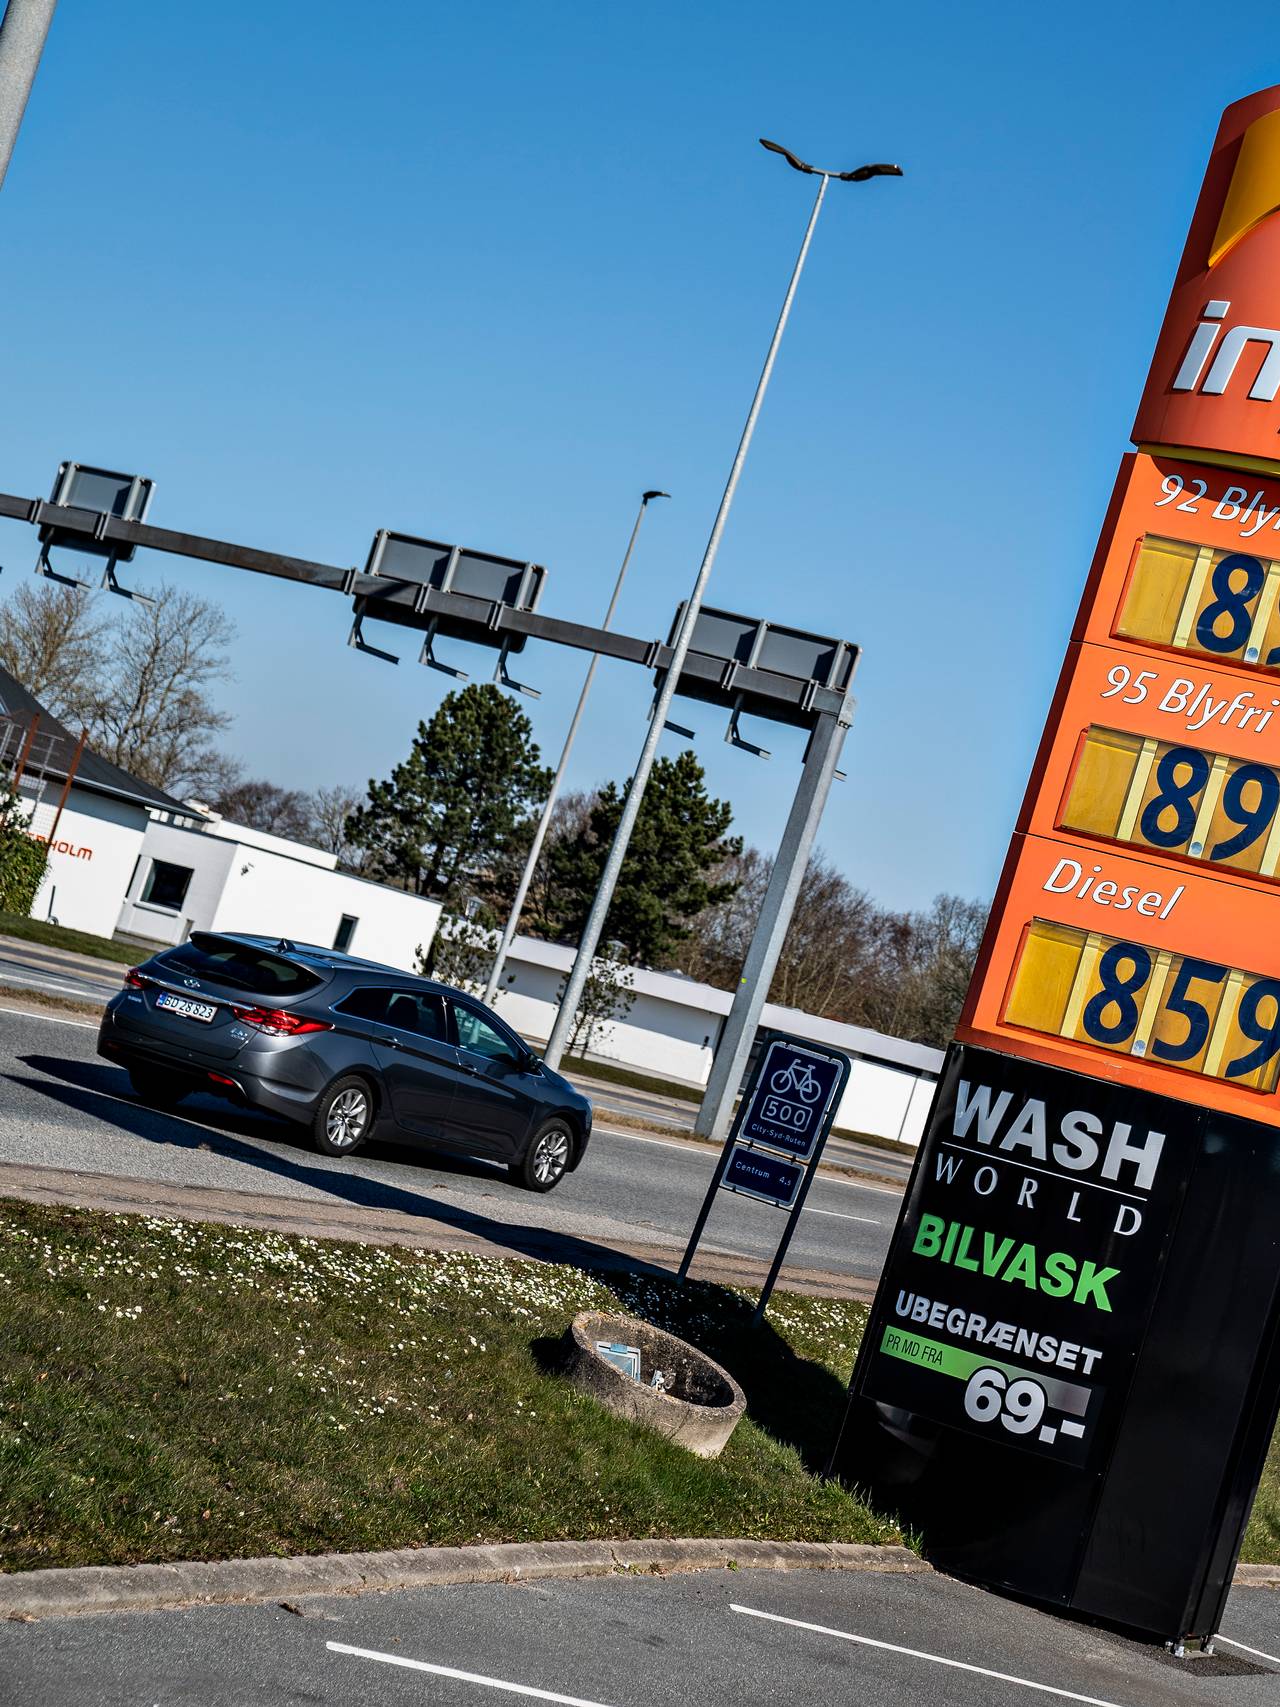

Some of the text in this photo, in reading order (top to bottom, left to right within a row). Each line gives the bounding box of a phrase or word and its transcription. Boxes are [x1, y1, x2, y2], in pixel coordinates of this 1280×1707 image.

[1154, 474, 1206, 514] 92
[1100, 664, 1280, 734] 95 Blyfri
[1042, 857, 1186, 920] Diesel
[766, 1101, 806, 1125] 500
[952, 1079, 1167, 1190] WASH
[735, 1161, 770, 1179] Centrum
[934, 1152, 1143, 1237] WORLD
[912, 1213, 1121, 1313] BILVASK
[886, 1333, 943, 1366] PR MD FRA
[895, 1290, 1103, 1375] UBEGRÆNSET
